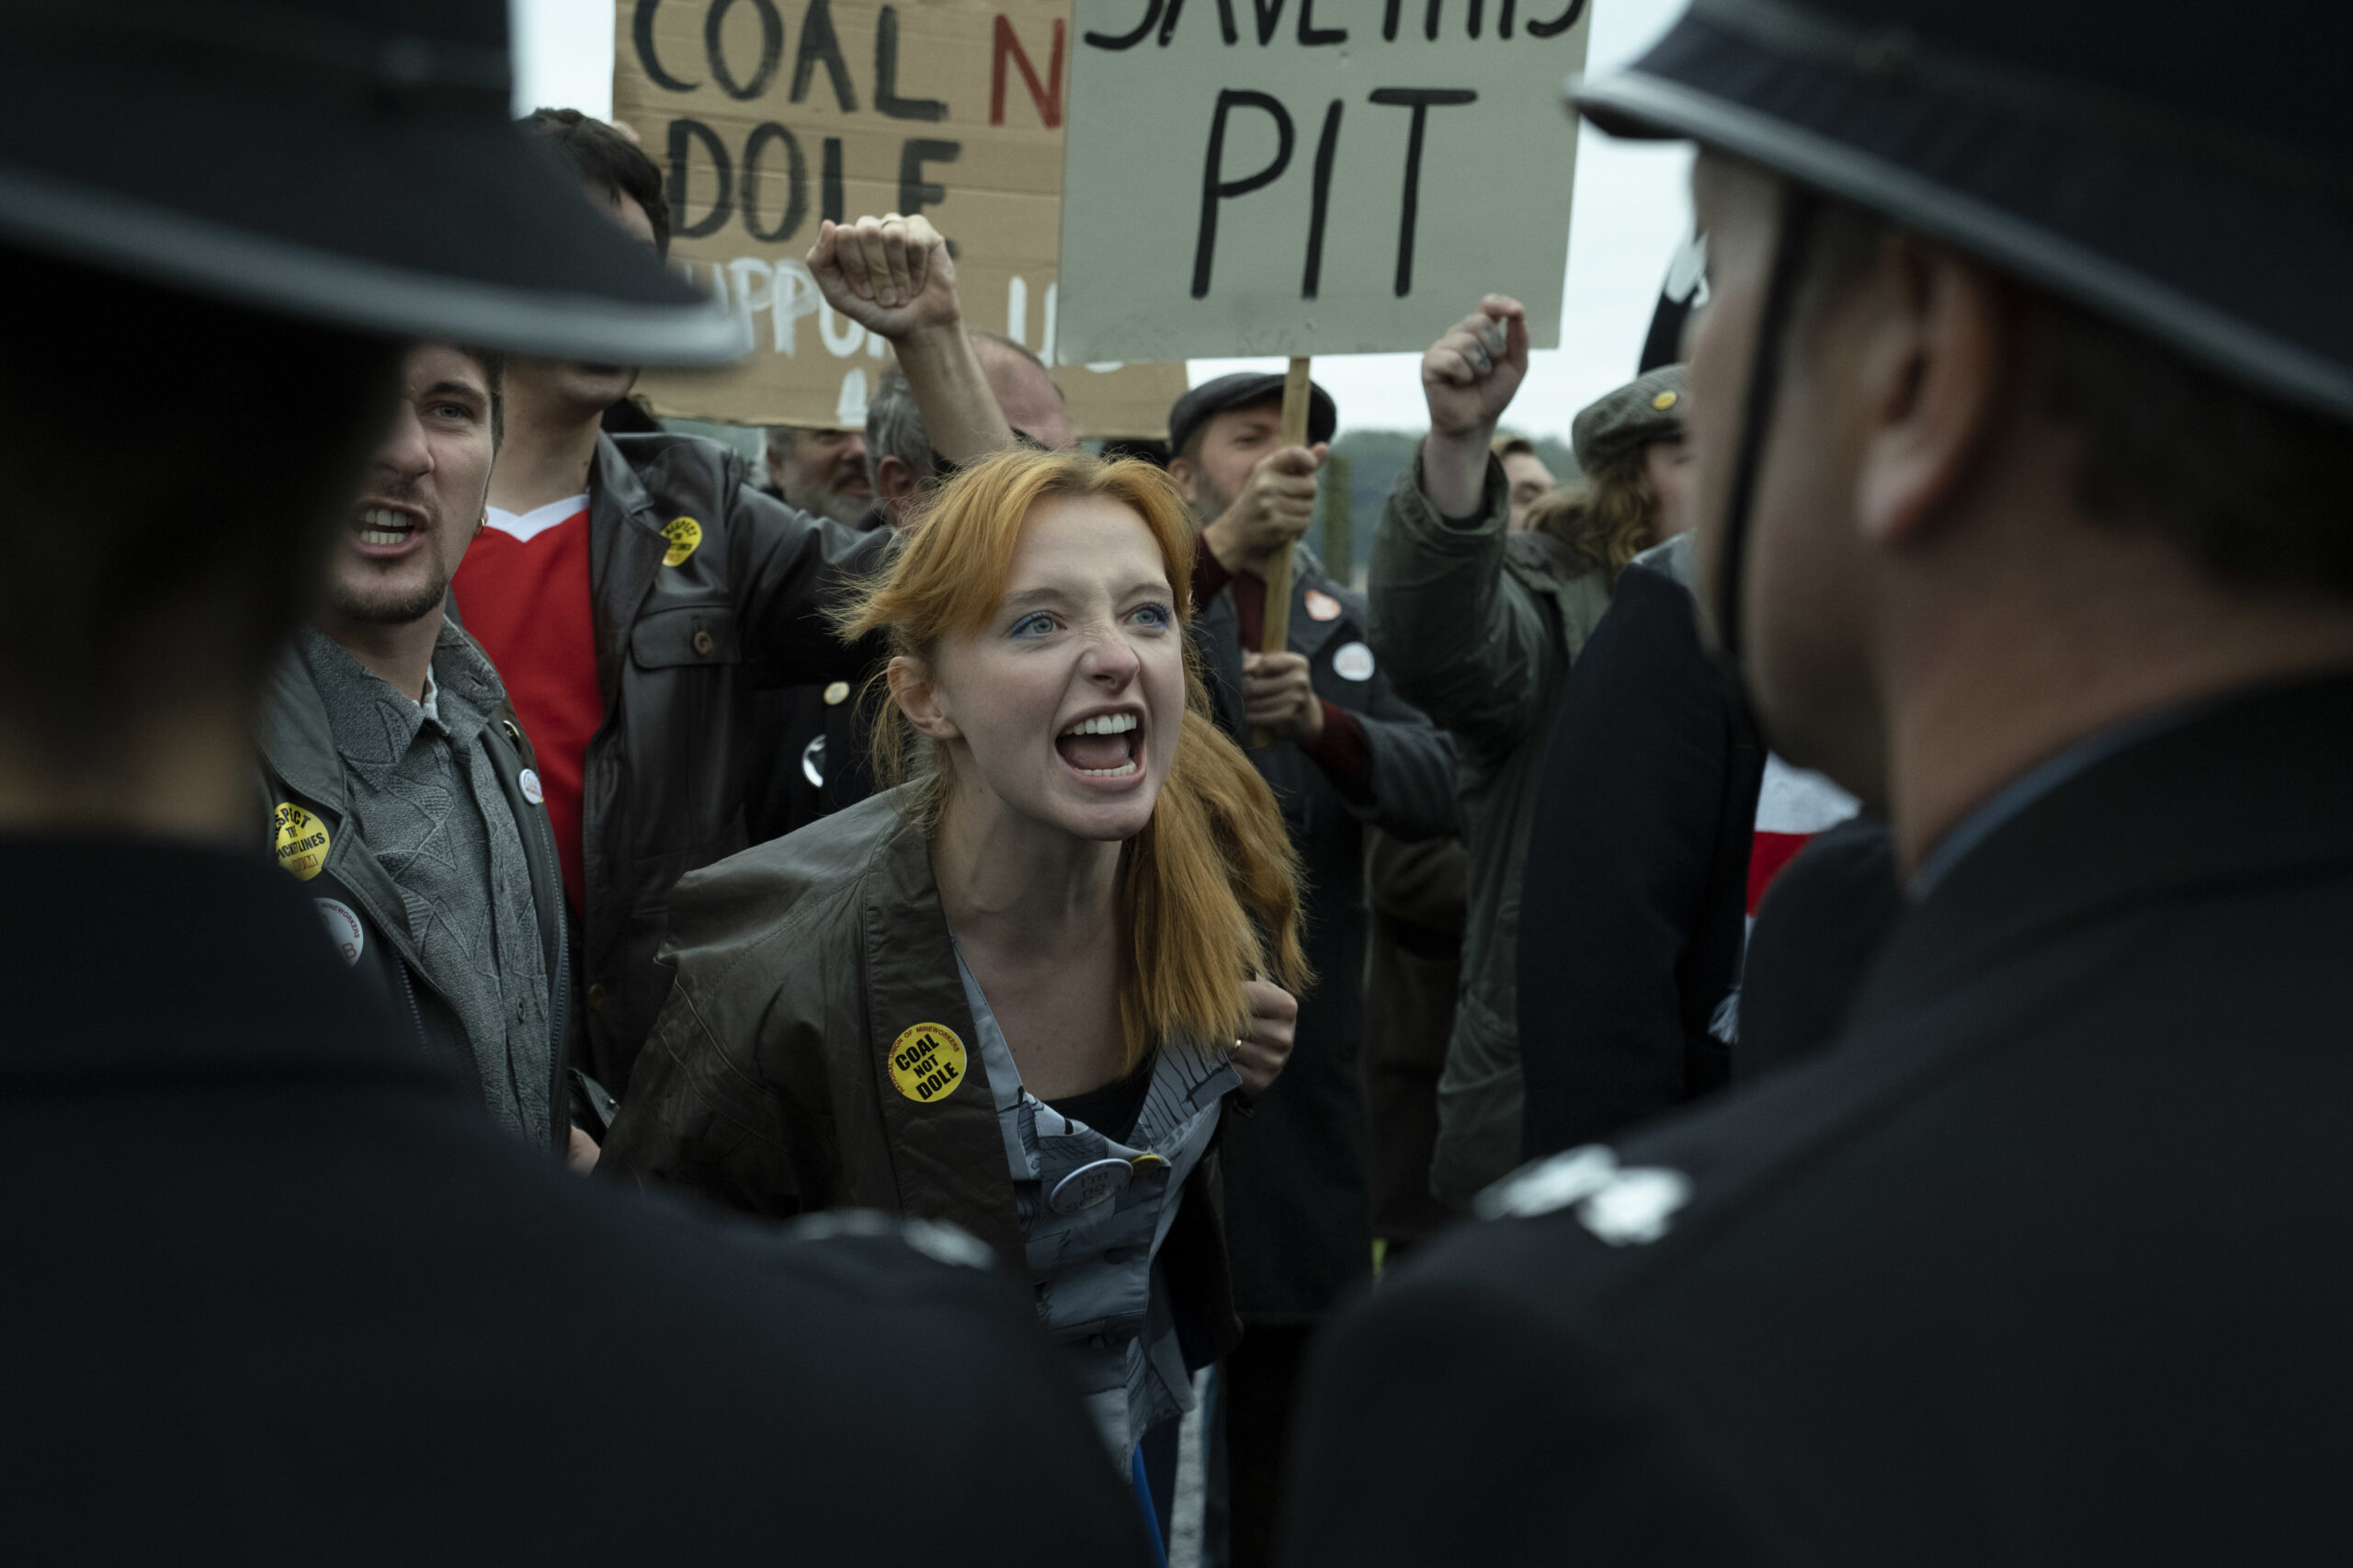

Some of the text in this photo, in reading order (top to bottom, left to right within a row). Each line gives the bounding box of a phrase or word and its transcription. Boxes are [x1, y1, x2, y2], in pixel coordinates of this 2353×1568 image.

[632, 0, 950, 122] COAL
[1191, 86, 1477, 300] PIT
[888, 1026, 960, 1094] NATIONAL UNION OF MINEWORKERS
[894, 1033, 939, 1071] COAL
[913, 1053, 939, 1079] NOT
[915, 1062, 960, 1101] DOLE
